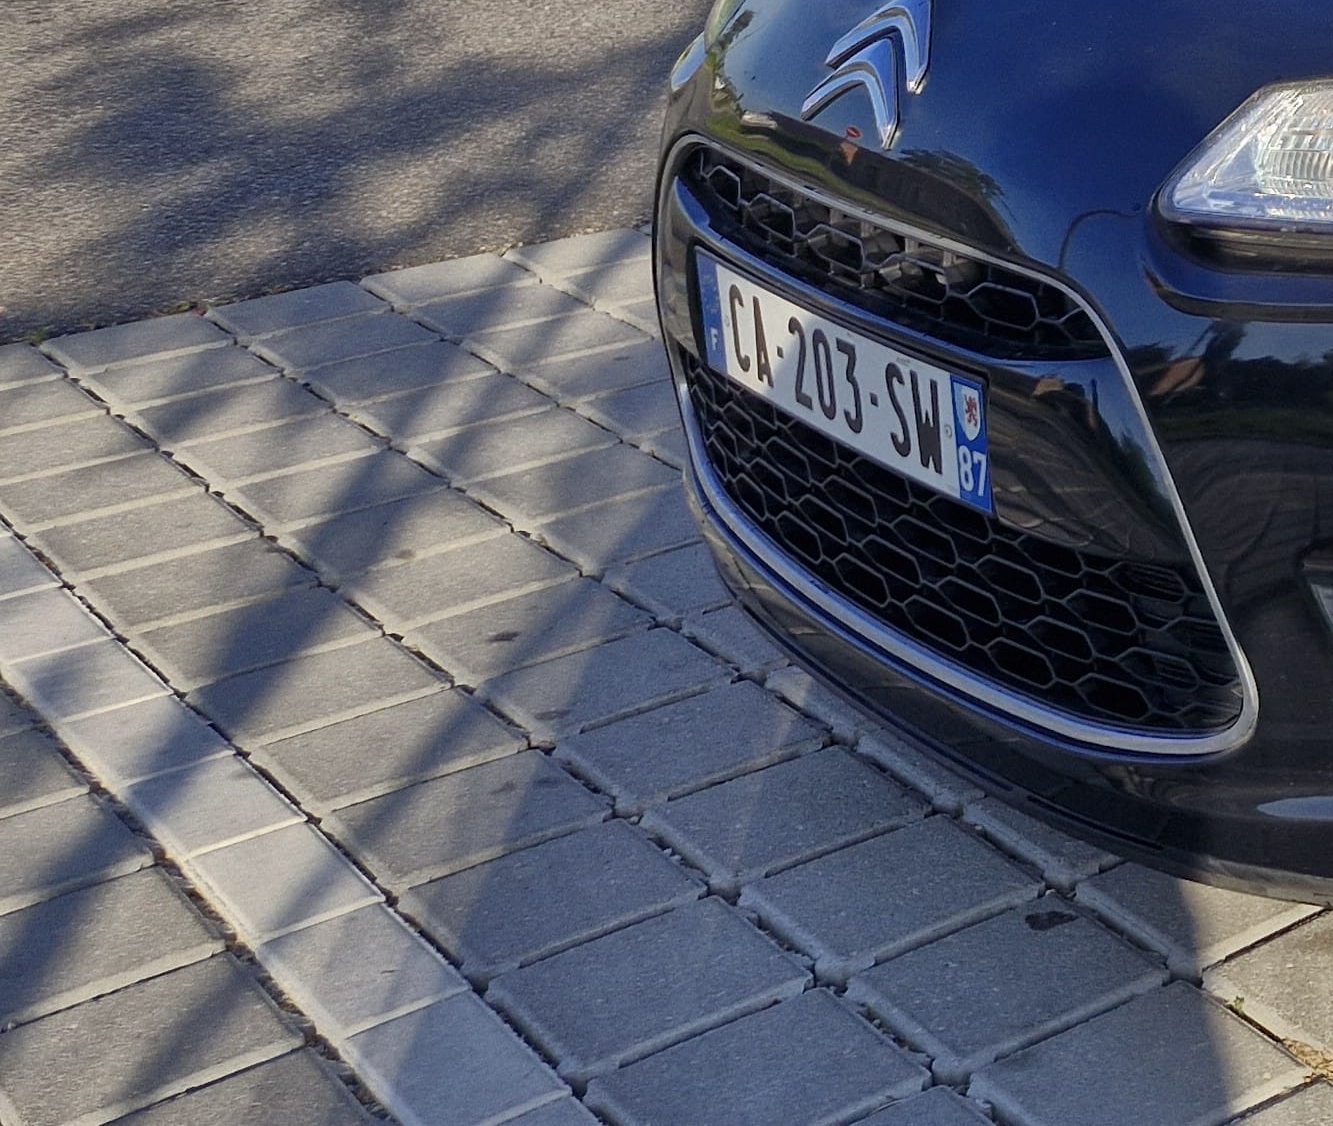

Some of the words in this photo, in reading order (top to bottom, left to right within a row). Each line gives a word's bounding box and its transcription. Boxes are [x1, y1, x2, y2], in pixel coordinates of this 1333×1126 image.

[710, 327, 719, 351] F
[729, 284, 943, 476] CA-203-SW
[959, 445, 987, 496] 87
